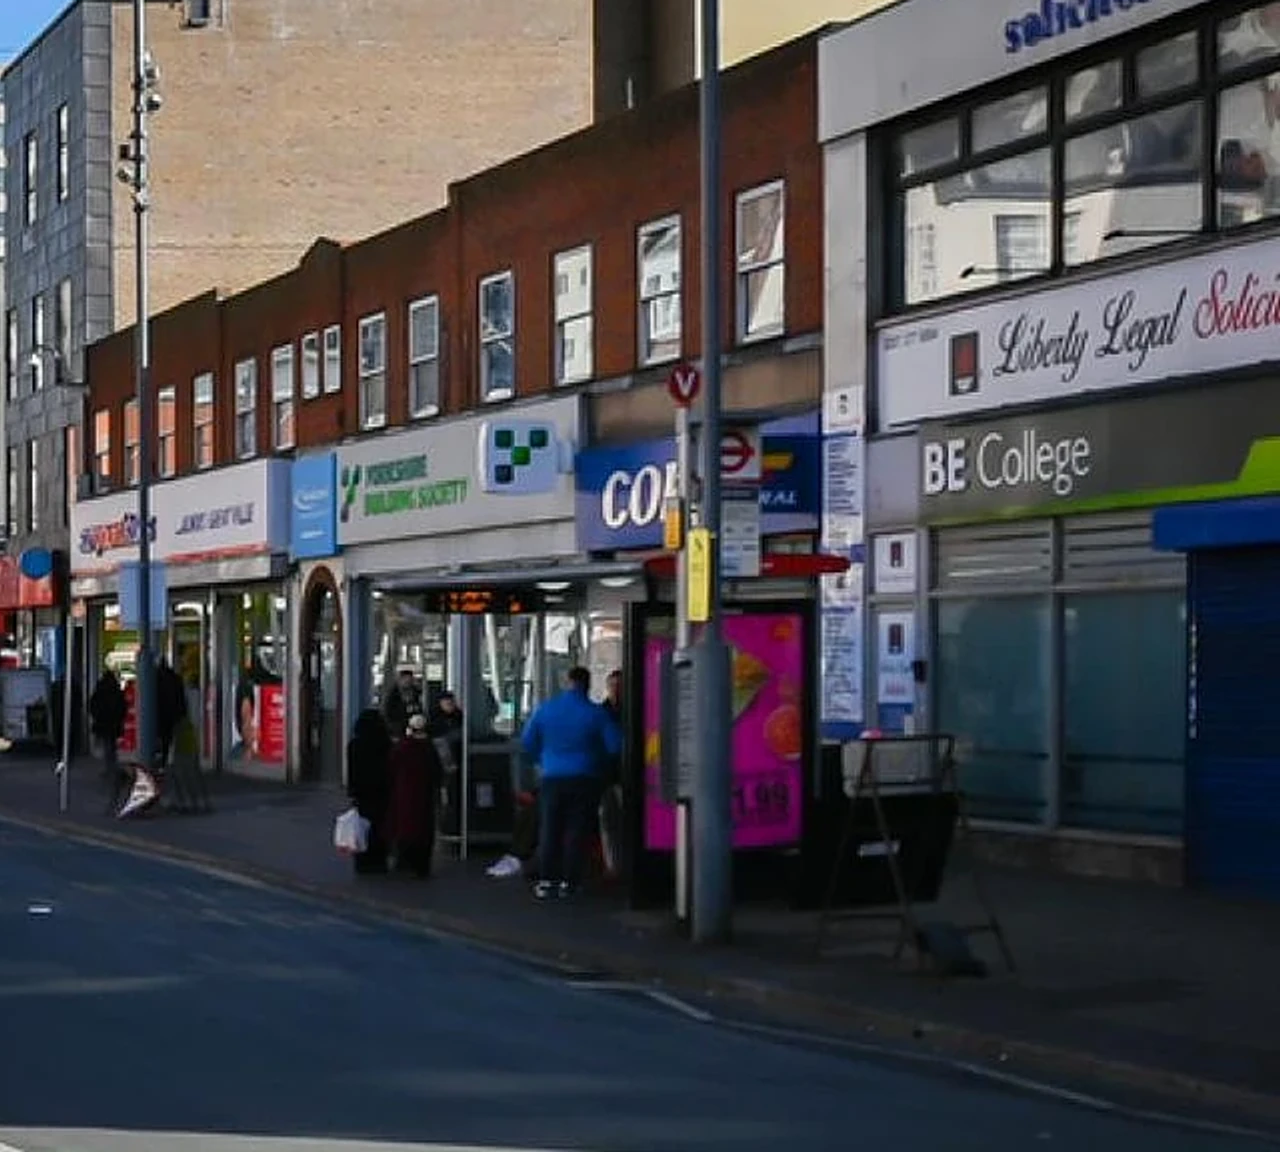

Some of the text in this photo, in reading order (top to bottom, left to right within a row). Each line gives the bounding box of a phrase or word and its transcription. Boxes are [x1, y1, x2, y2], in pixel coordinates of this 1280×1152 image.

[1095, 287, 1188, 372] Legal
[674, 371, 696, 396] V
[924, 438, 966, 496] BE
[976, 429, 1090, 496] College
